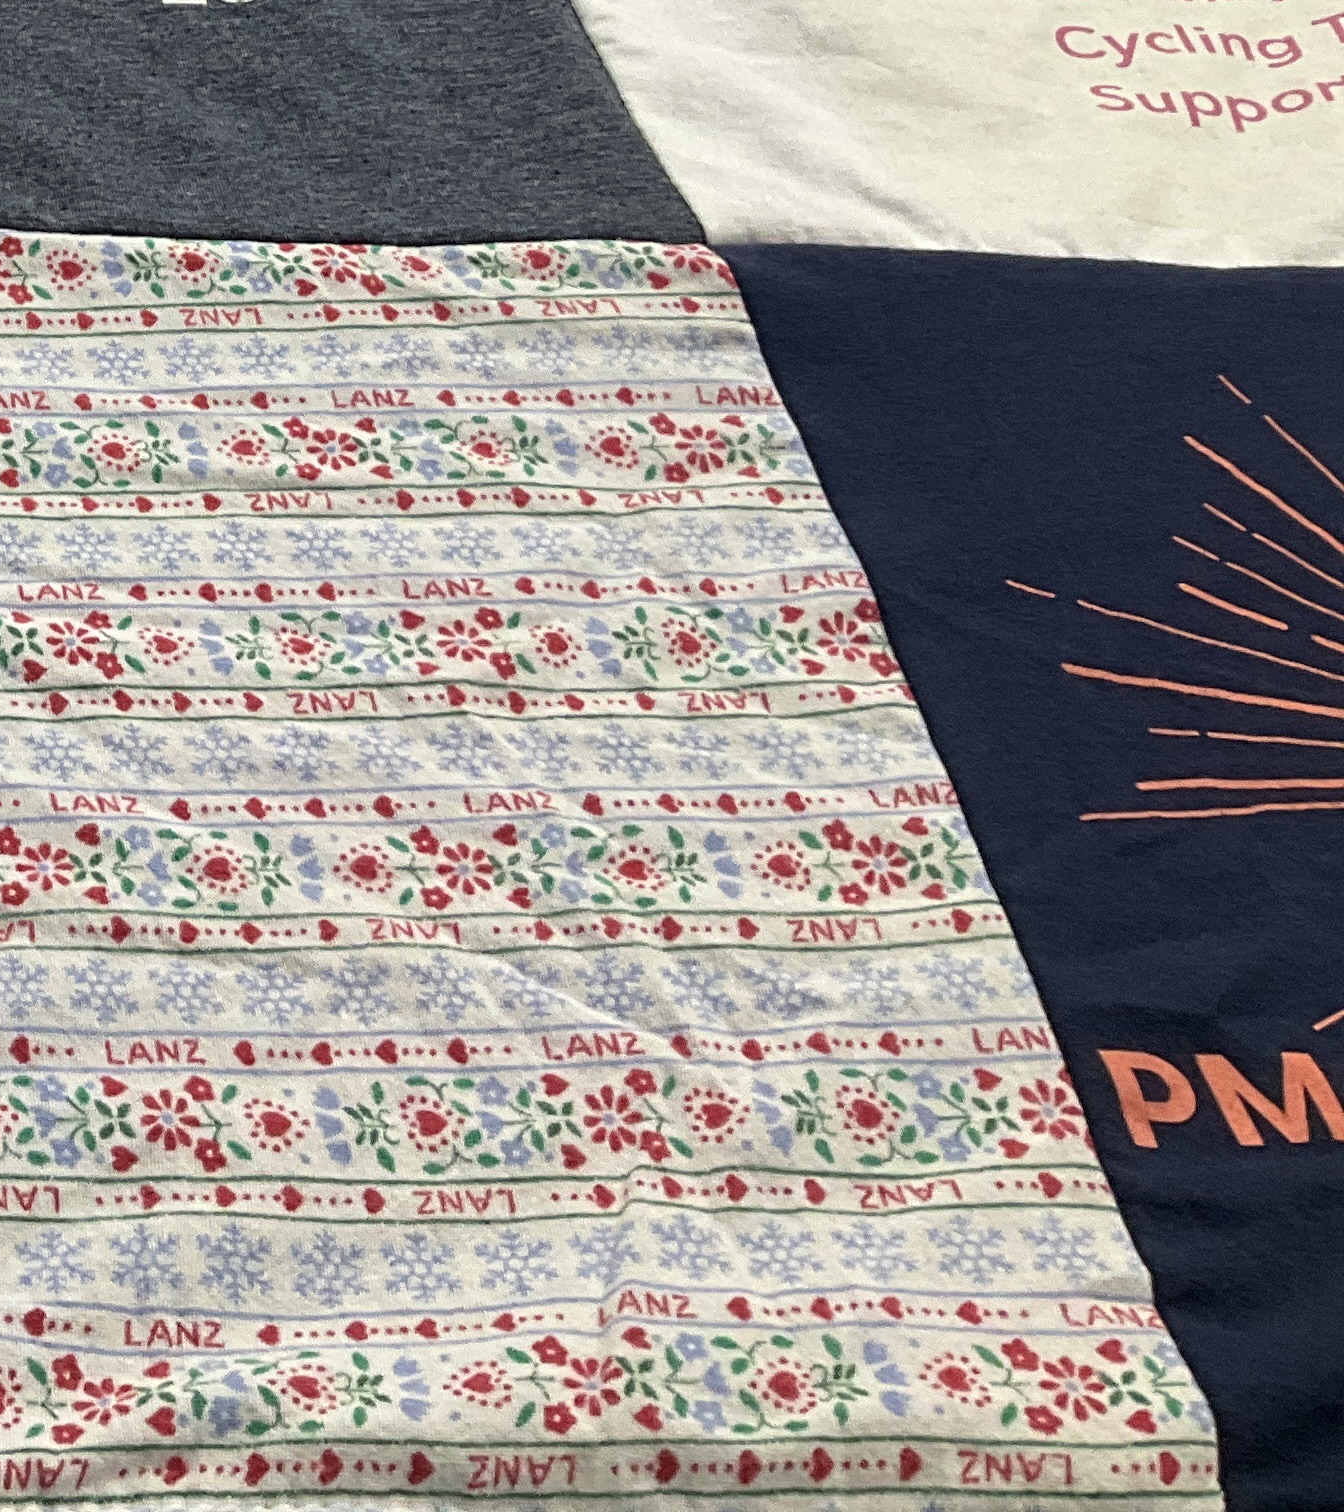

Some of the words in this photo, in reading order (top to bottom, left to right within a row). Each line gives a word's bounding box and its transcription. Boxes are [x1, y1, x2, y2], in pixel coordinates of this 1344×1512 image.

[1053, 24, 1304, 70] Cycling
[180, 308, 262, 326] LANZ
[541, 299, 619, 316] LANZ
[334, 388, 413, 408] LANZ
[248, 494, 332, 511] LANZ
[620, 491, 703, 508] LANZ
[18, 584, 104, 602] LANZ
[403, 578, 491, 599] LANZ
[289, 691, 377, 714] LANZ
[686, 693, 770, 712] LANZ
[50, 793, 143, 813] LANZ
[464, 792, 559, 813] LANZ
[368, 918, 461, 942] LANZ
[788, 919, 881, 942] LANZ
[105, 1039, 206, 1066] LANZ
[543, 1032, 645, 1057] LANZ
[415, 1189, 516, 1214] LANZ
[859, 1180, 961, 1208] LANZ
[124, 1320, 224, 1348] LANZ
[469, 1455, 576, 1489] LANZ
[959, 1450, 1072, 1485] LANZ
